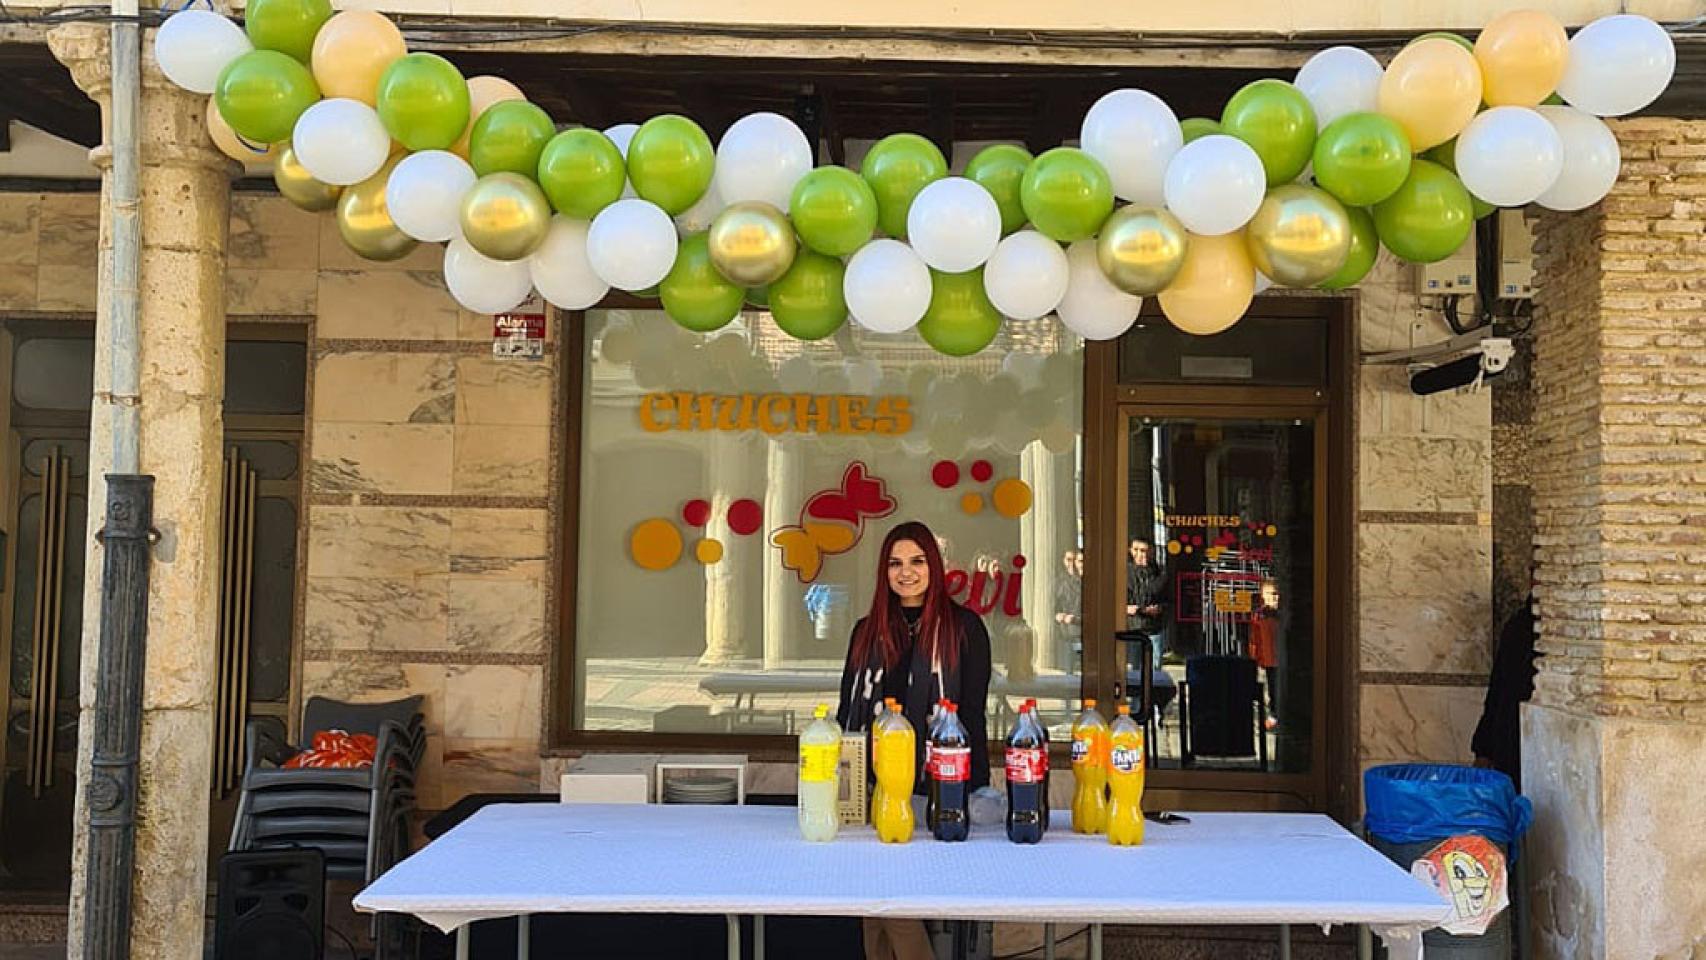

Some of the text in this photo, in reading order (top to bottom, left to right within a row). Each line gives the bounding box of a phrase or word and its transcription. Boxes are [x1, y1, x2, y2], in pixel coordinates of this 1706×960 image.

[496, 315, 544, 328] Alarma
[639, 391, 913, 435] CHUCHES
[1165, 514, 1240, 527] CHUCHES
[944, 554, 1027, 616] evi
